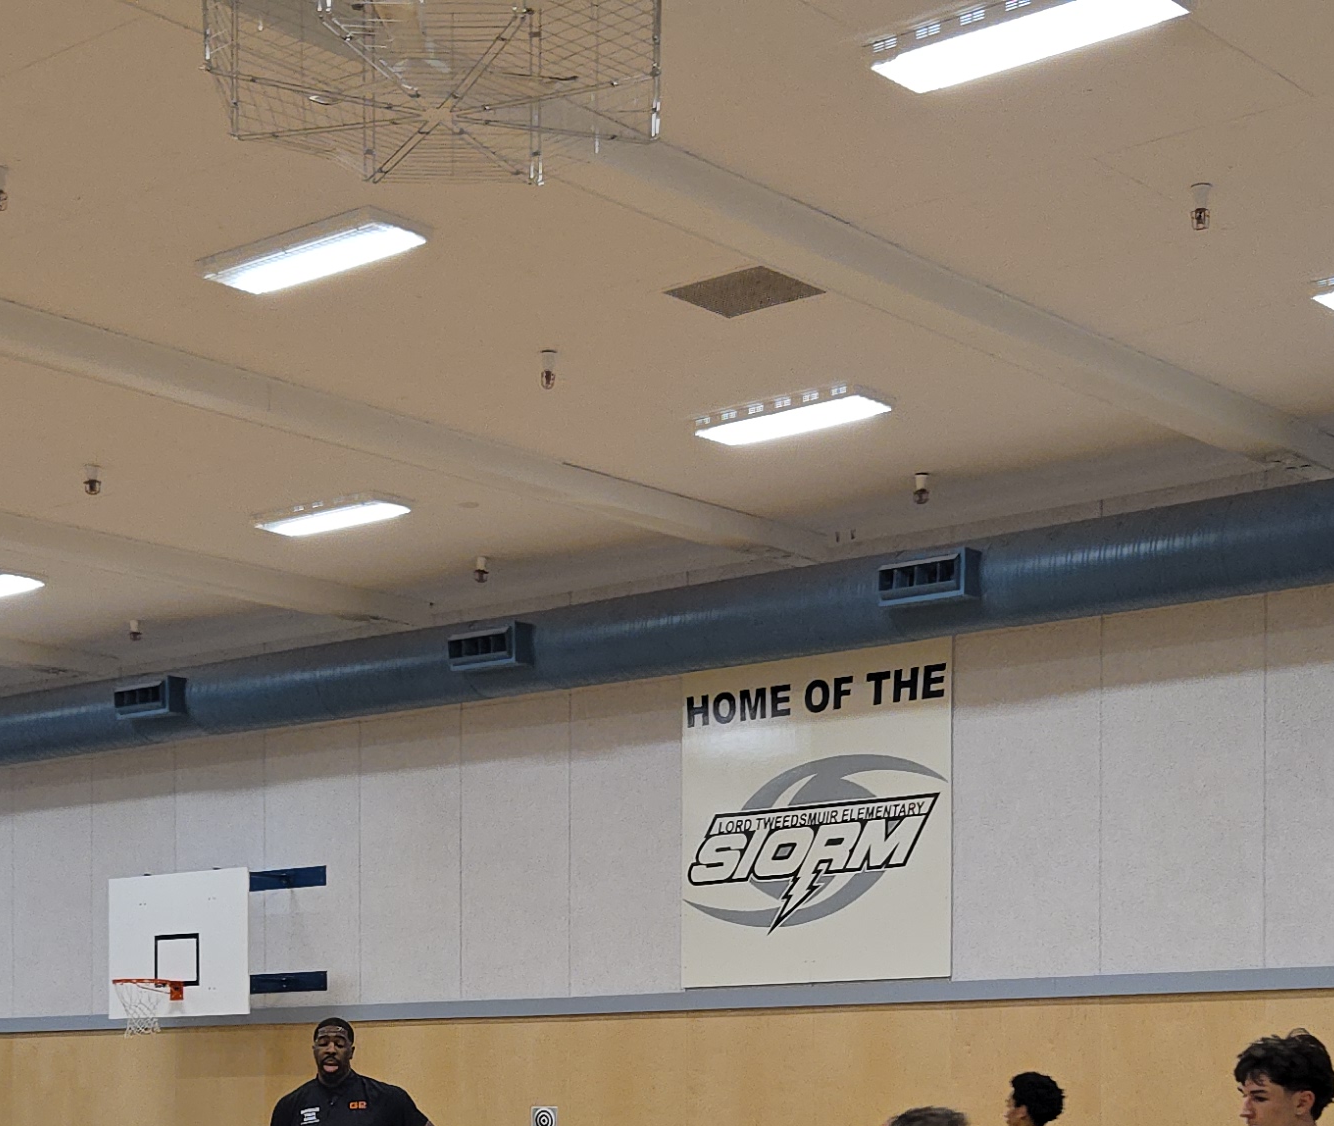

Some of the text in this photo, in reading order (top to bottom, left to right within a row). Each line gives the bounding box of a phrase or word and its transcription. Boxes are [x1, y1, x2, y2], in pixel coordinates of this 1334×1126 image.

[686, 663, 947, 728] HOME OF THE
[718, 801, 926, 834] LORD TWEEDSMUIR ELEMENTARY
[688, 813, 929, 910] STORM
